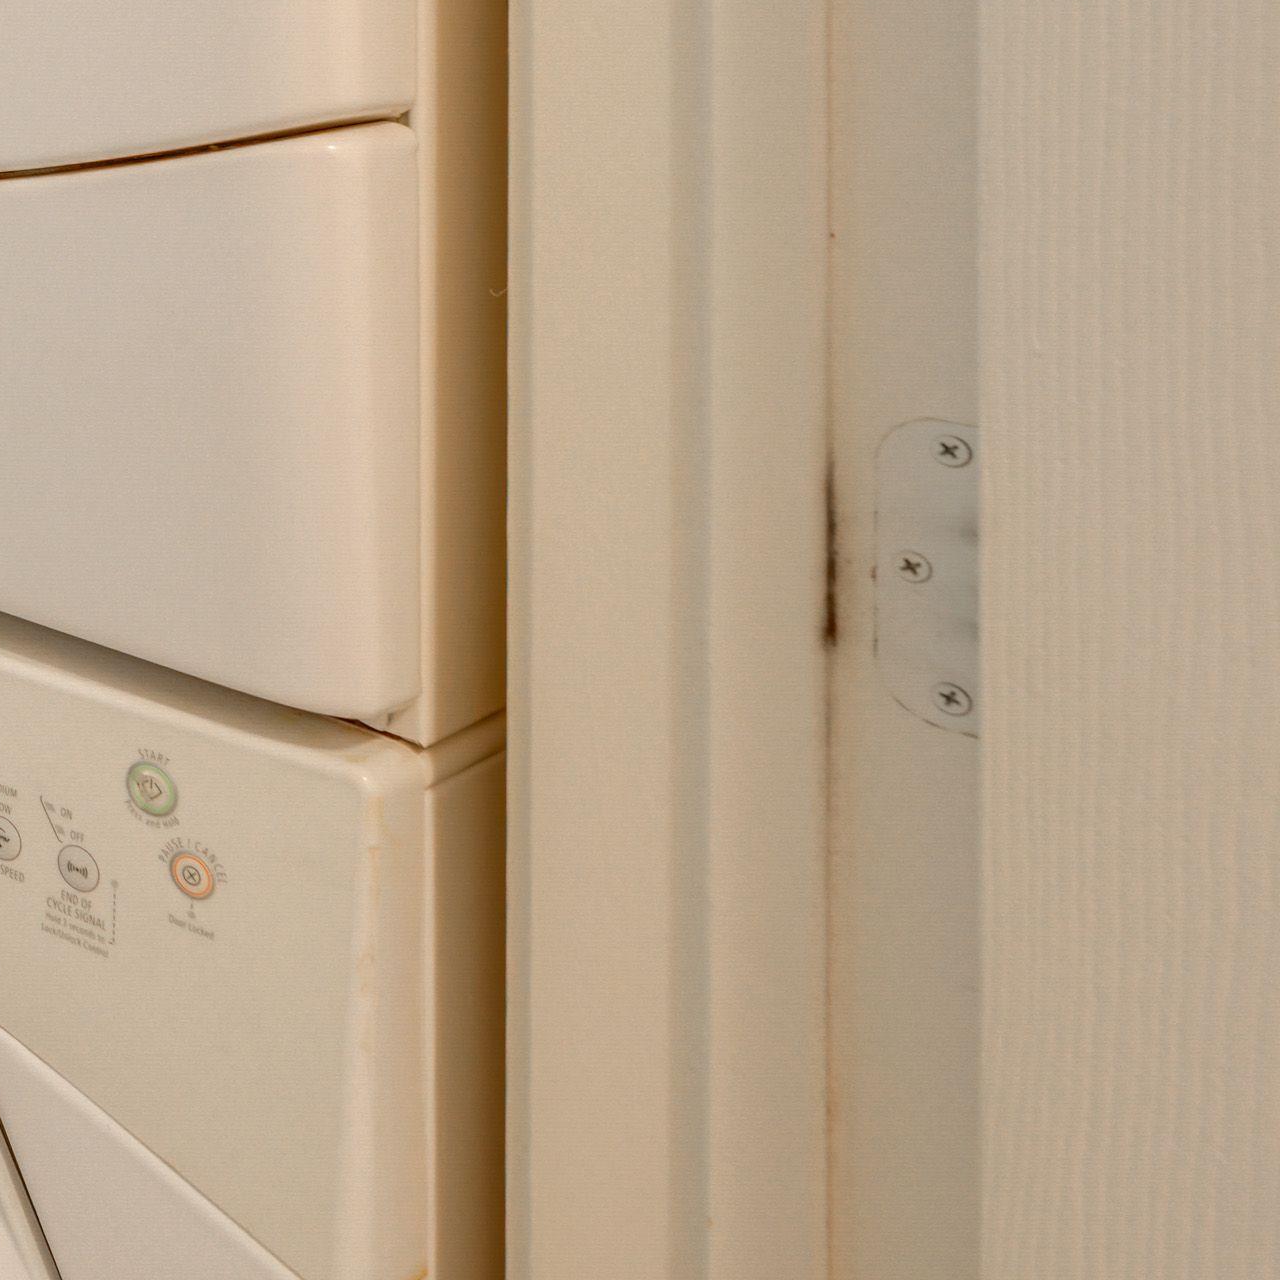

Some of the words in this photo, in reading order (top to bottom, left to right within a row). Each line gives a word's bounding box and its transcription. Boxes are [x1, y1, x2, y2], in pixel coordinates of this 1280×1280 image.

[138, 748, 171, 767] START
[60, 807, 73, 820] ON
[70, 829, 85, 842] OFF
[157, 837, 183, 864] PAUSE
[194, 841, 228, 885] CANCEL
[0, 862, 25, 883] SPEED
[60, 889, 79, 905] END
[80, 896, 92, 910] OF
[46, 896, 72, 917] CYCLE
[74, 908, 107, 931] SIGNAL
